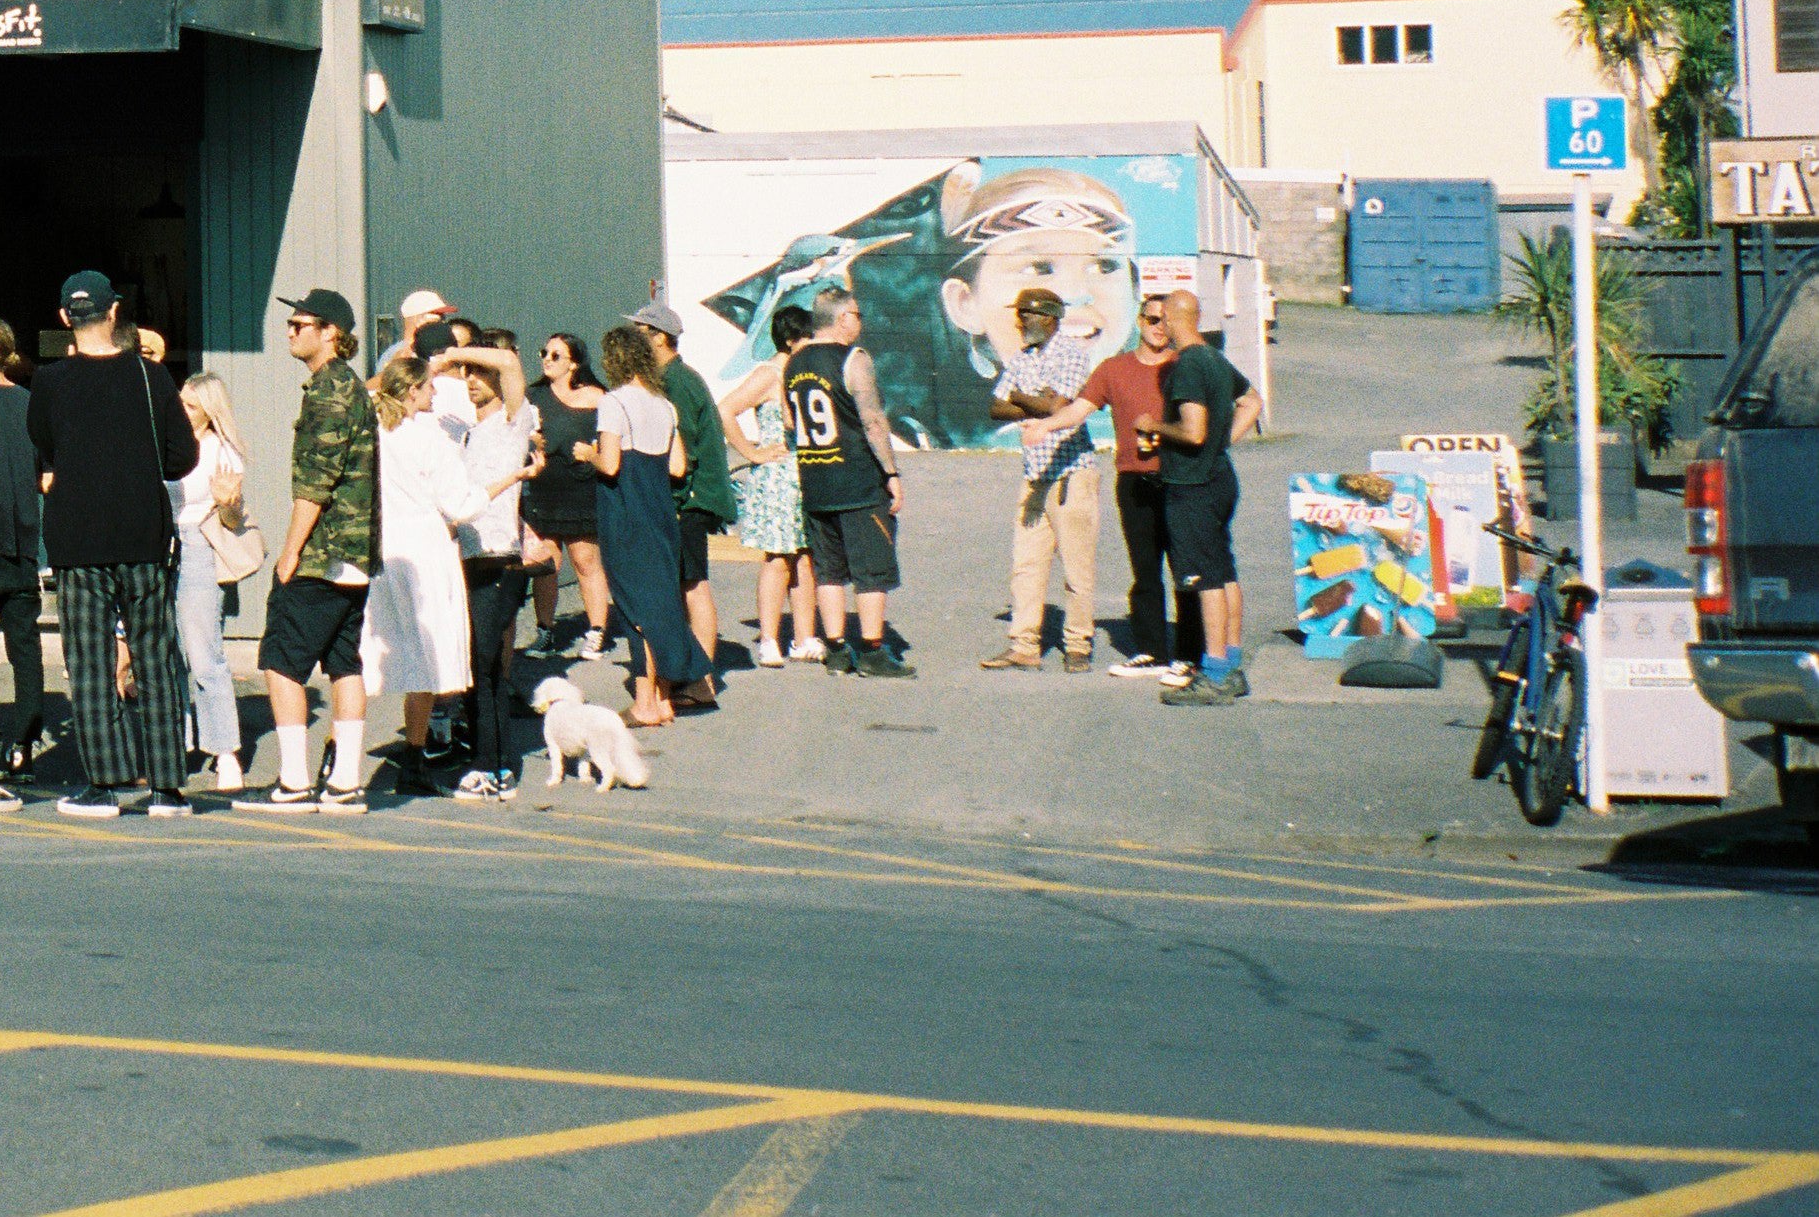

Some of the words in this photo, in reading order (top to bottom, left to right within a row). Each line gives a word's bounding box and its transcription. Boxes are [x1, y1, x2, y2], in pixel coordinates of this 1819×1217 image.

[1570, 99, 1599, 129] P
[1569, 130, 1603, 154] 60
[789, 388, 838, 447] 19
